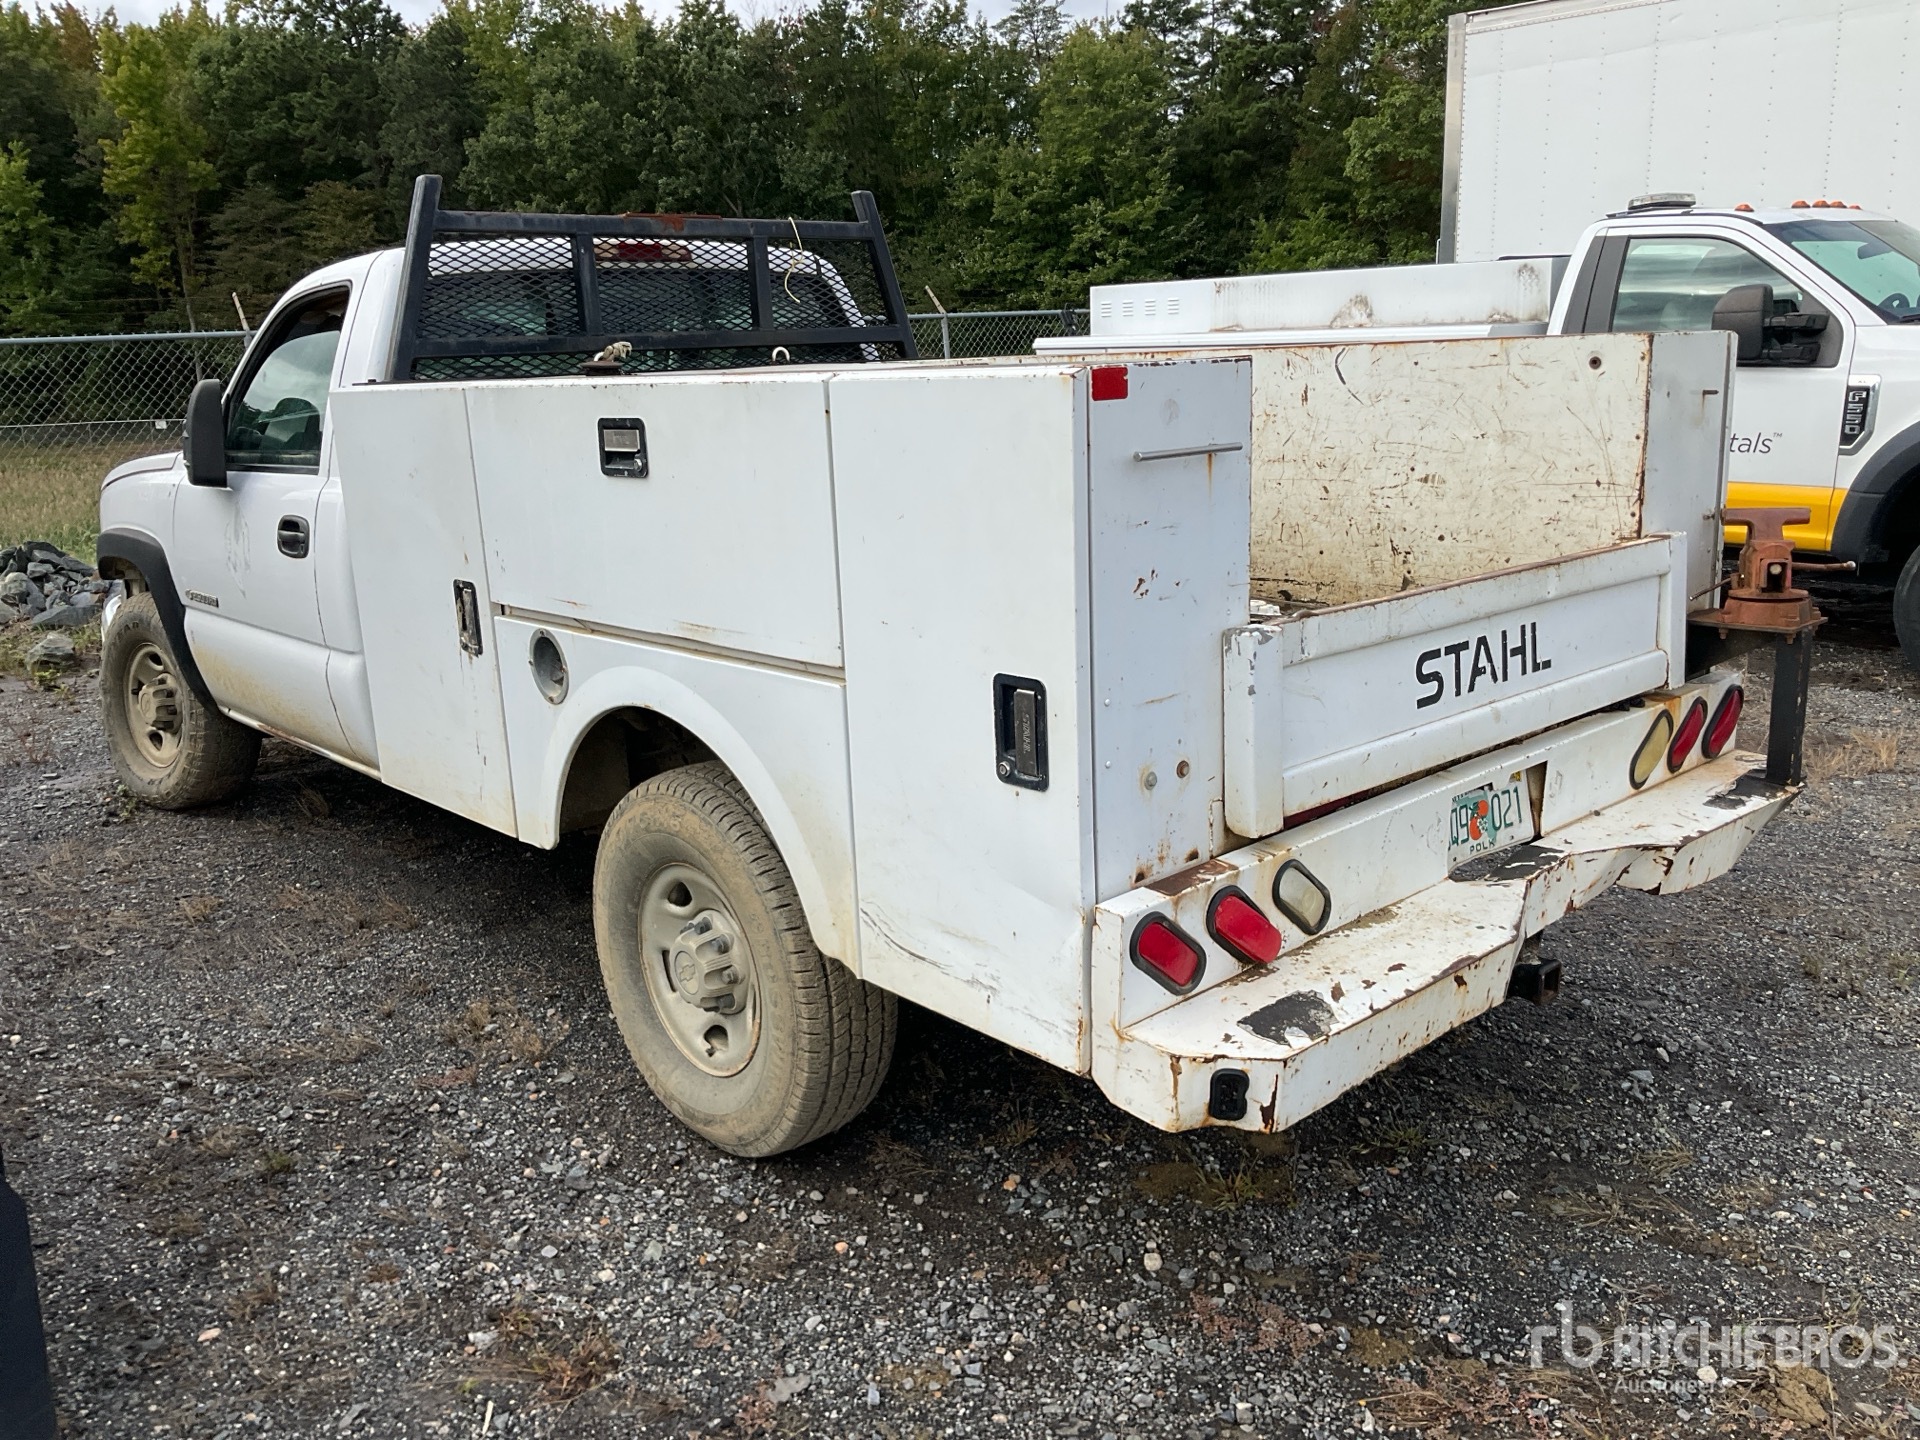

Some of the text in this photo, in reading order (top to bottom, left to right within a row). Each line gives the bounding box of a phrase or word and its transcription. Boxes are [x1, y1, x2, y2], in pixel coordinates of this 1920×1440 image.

[1416, 621, 1552, 709] STAHL
[1448, 786, 1522, 851] Q9 021
[1469, 839, 1495, 855] POLK
